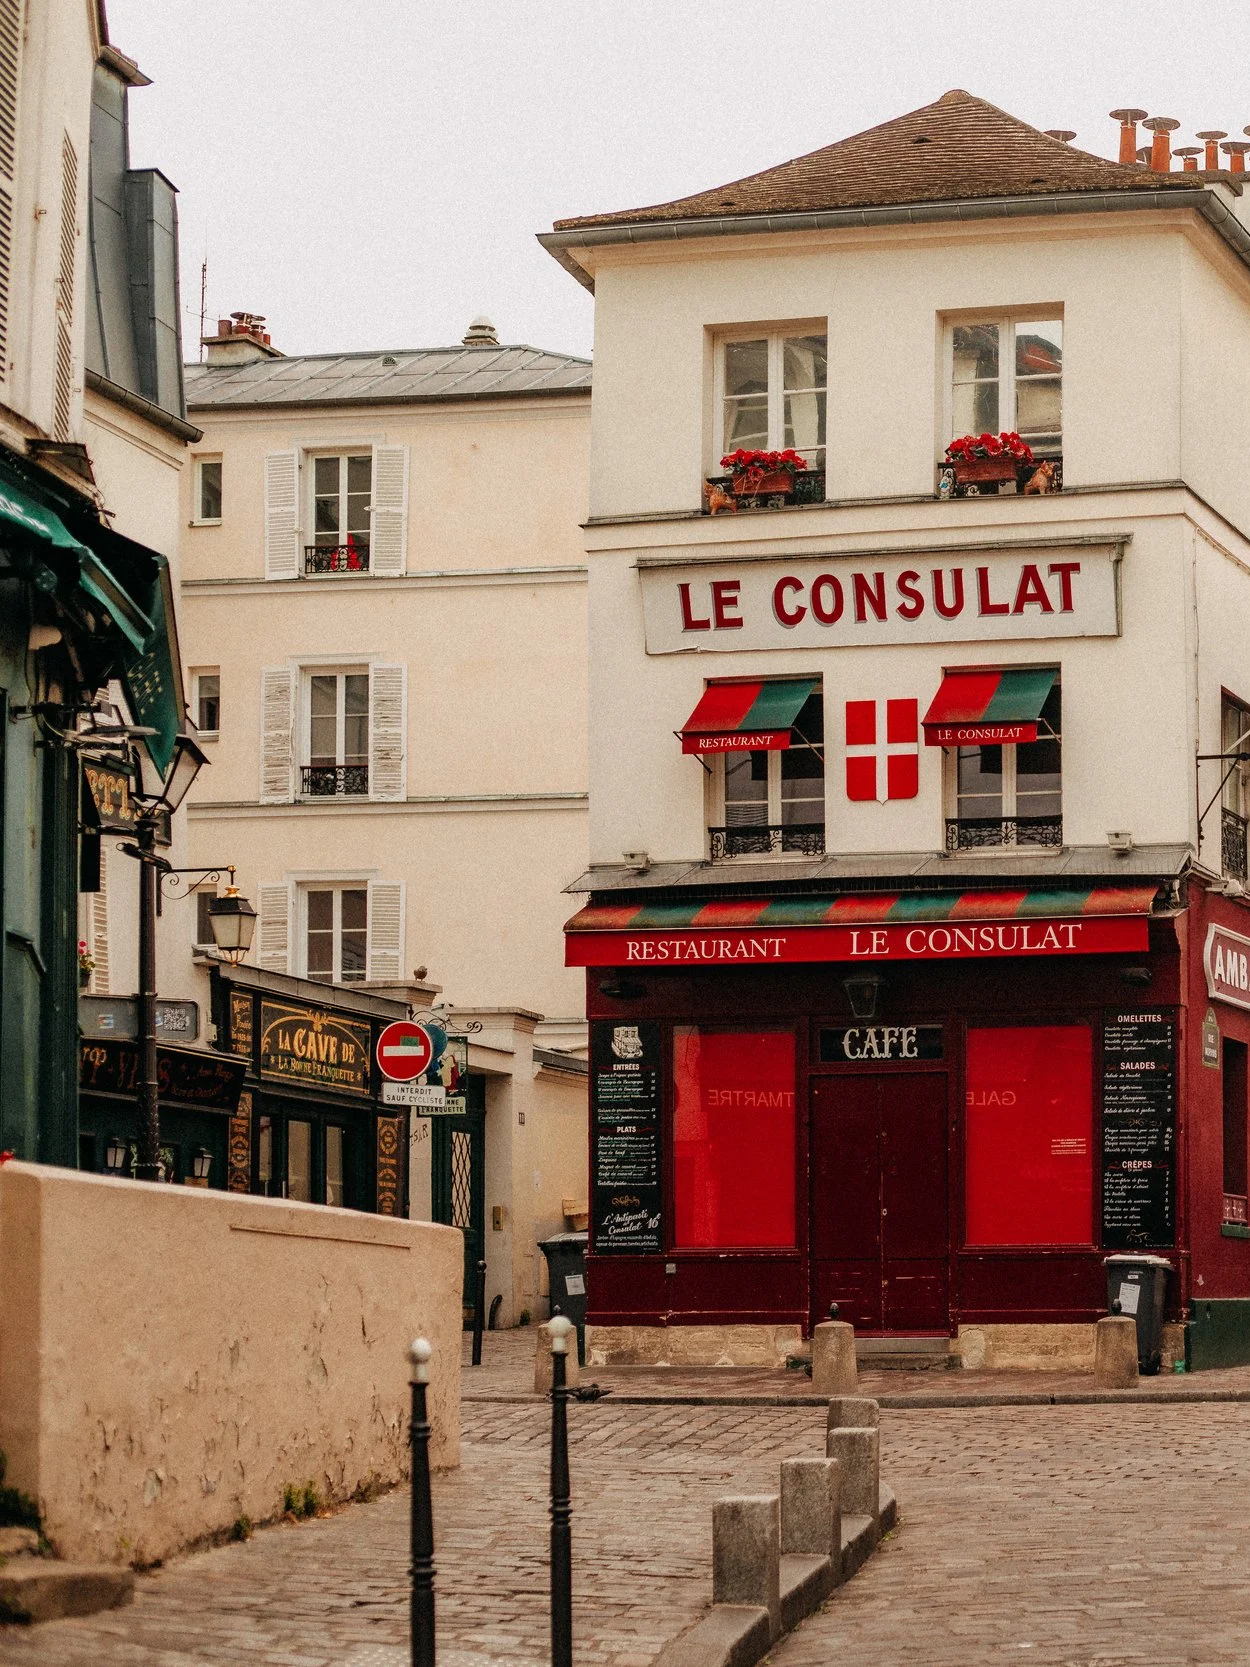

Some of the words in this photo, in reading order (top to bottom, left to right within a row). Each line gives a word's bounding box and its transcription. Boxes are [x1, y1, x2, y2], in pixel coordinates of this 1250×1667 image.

[677, 580, 744, 632] LE
[772, 562, 1081, 629] CONSULAT
[938, 730, 953, 740] LE
[957, 727, 1023, 740] CONSULAT
[699, 735, 774, 748] RESTAURANT
[626, 938, 786, 961] RESTAURANT
[850, 931, 889, 955] LE
[905, 924, 1082, 953] CONSULAT
[1117, 1014, 1162, 1023] OMELETTES
[279, 1029, 291, 1051] LA
[293, 1028, 338, 1064] CAVE
[342, 1042, 355, 1063] DE
[842, 1026, 918, 1059] CAFE
[278, 1055, 288, 1070] LA
[290, 1058, 312, 1073] BONNE
[312, 1062, 355, 1081] FRANQUETTE
[1120, 1061, 1156, 1070] SALADES
[397, 1086, 432, 1095] INTERDIT
[386, 1094, 405, 1102] SAUF
[409, 1095, 443, 1105] CYCLISTE
[421, 1105, 464, 1113] FRANQUETTE
[1122, 1160, 1152, 1168] CRÊPES
[608, 1222, 643, 1235] Consulat
